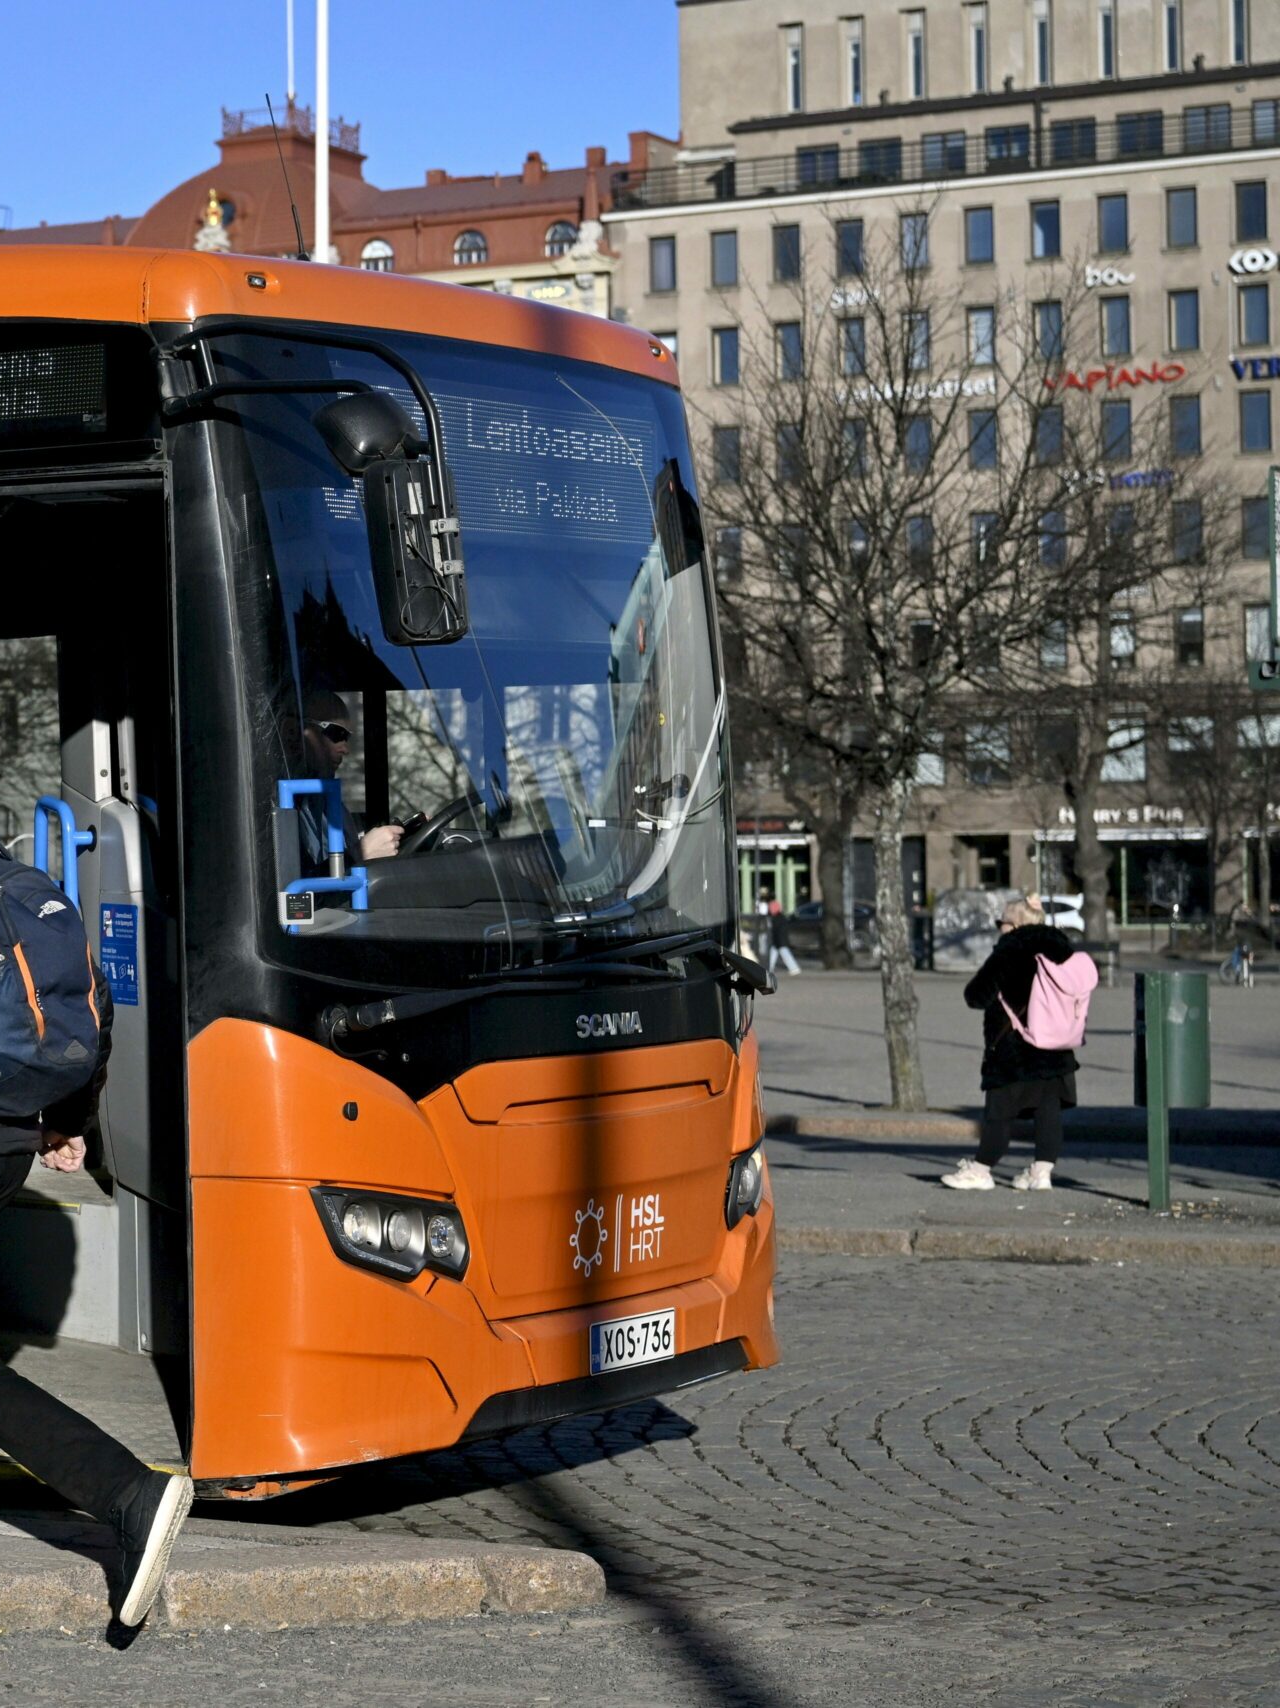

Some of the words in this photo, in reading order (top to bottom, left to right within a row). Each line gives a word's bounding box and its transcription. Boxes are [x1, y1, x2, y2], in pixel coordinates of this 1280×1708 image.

[467, 402, 644, 467] Lentoasema
[495, 478, 529, 515] via
[536, 481, 619, 523] Pakkala
[1058, 805, 1139, 824] HRY'S
[576, 1010, 643, 1038] SCANIA
[630, 1194, 665, 1227] HSL
[629, 1226, 665, 1263] HRT
[604, 1318, 671, 1364] XOS-736
